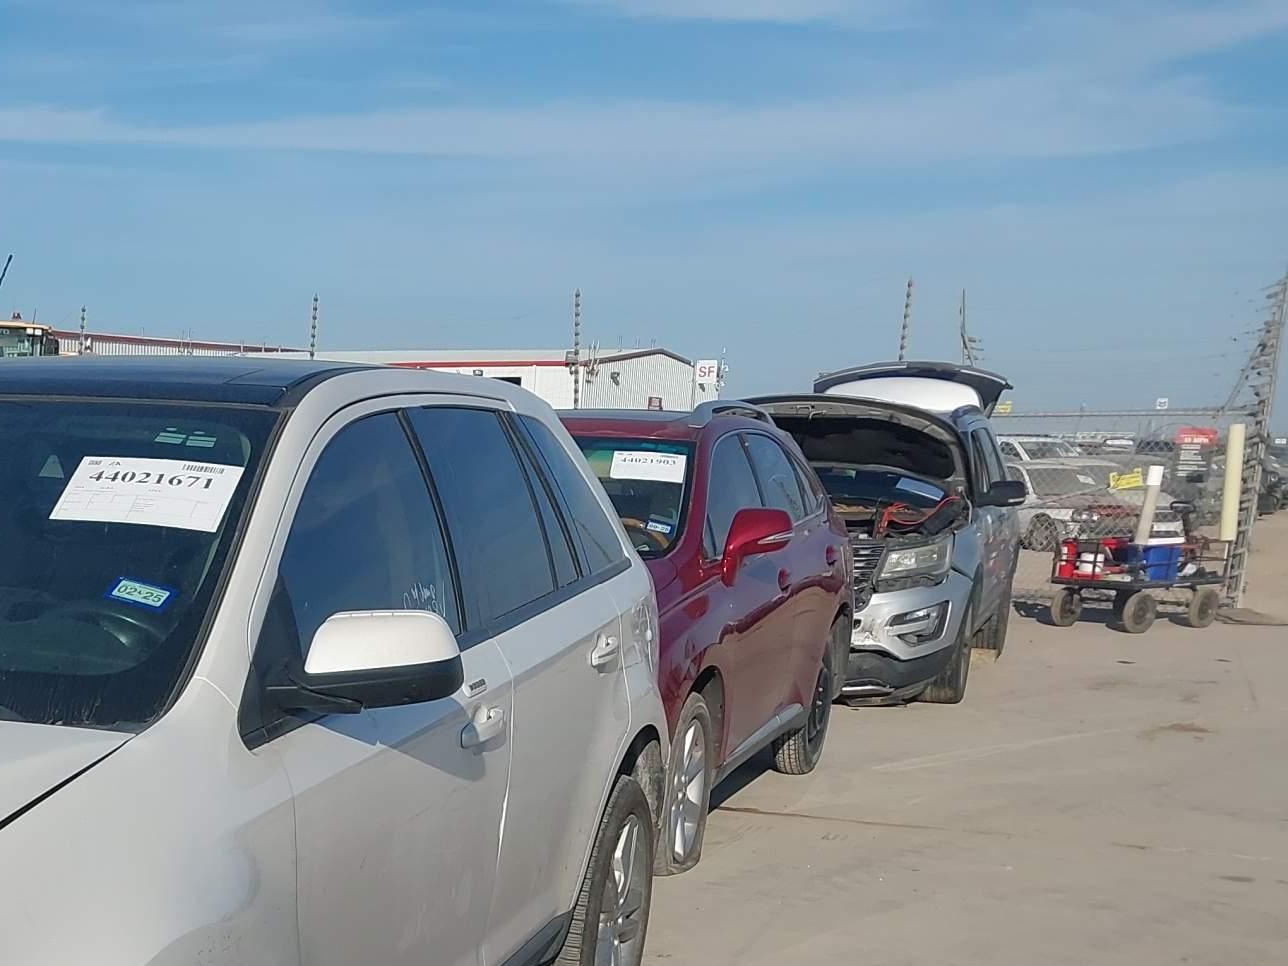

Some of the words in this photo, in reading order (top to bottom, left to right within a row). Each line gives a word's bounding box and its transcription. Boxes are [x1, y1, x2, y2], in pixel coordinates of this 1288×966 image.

[698, 366, 715, 378] SF
[621, 457, 676, 465] 44021903
[88, 470, 214, 489] 44021671
